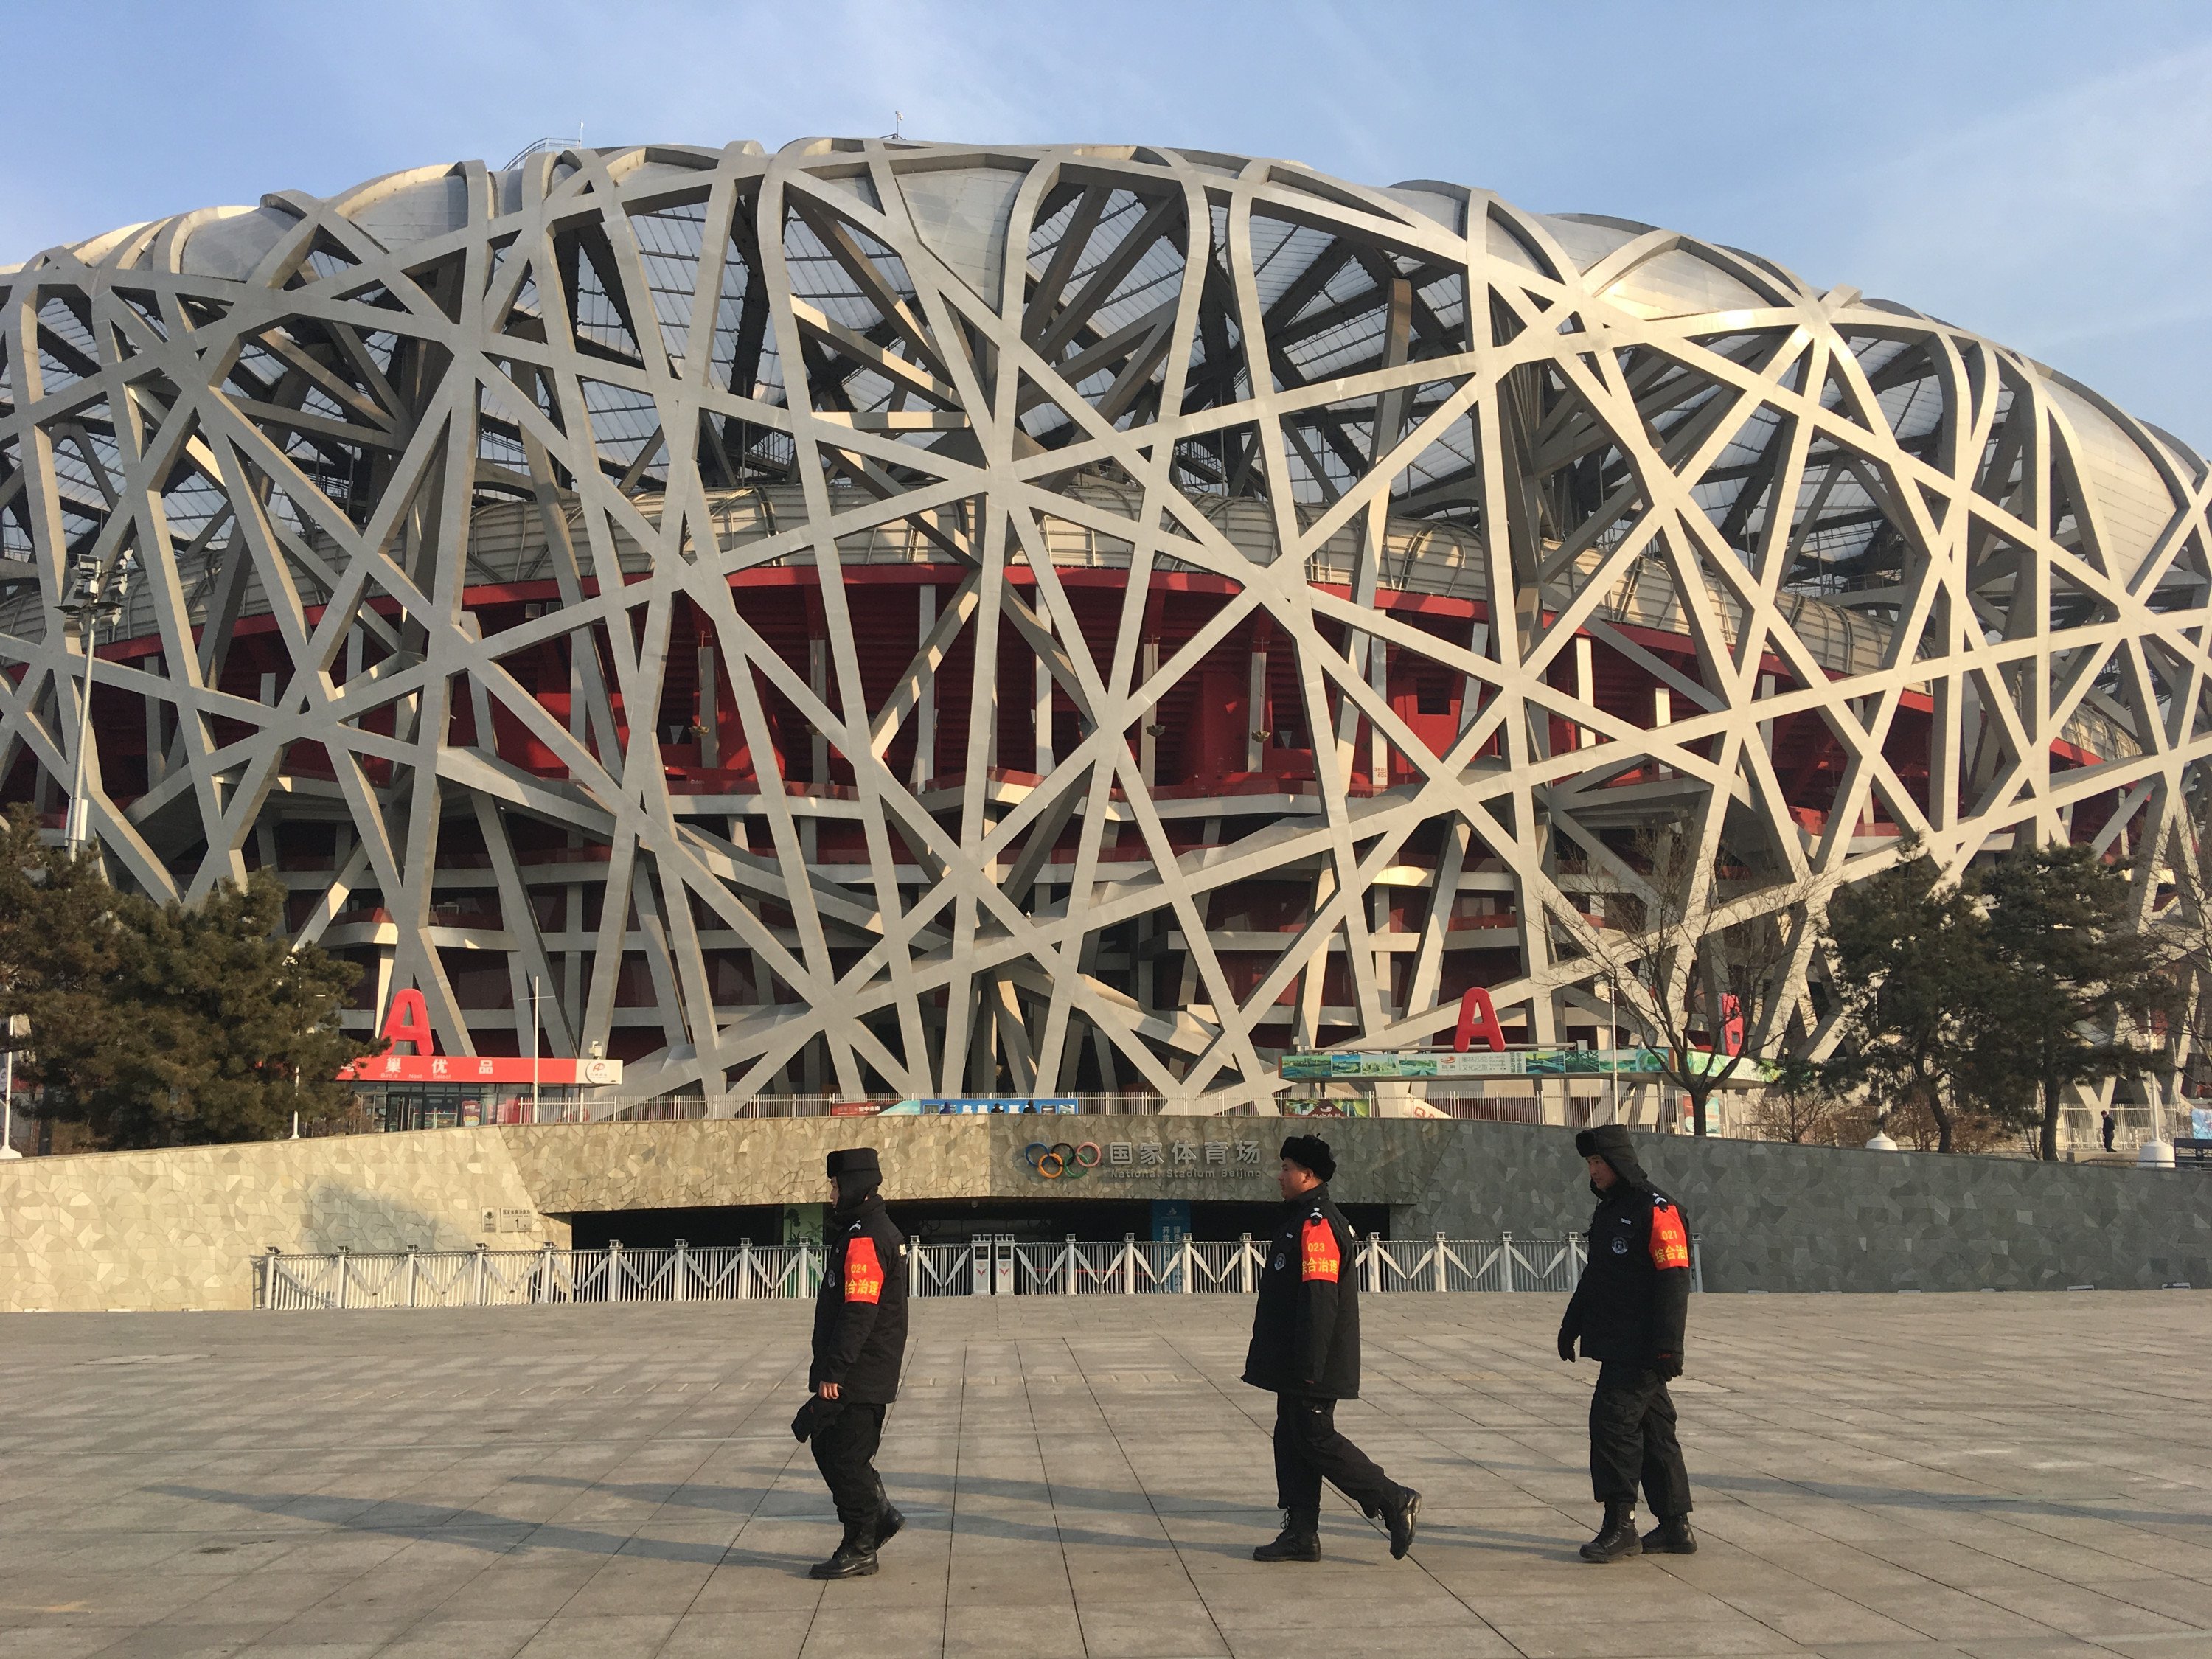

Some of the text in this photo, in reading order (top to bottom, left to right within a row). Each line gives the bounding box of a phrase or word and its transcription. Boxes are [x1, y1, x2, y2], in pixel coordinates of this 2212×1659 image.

[380, 989, 434, 1055] A
[1453, 987, 1506, 1052] A
[1110, 1140, 1261, 1164] 国家体育场
[1111, 1169, 1262, 1178] National Stadium Beijing
[1662, 1230, 1677, 1240] 021
[1307, 1243, 1325, 1252] 023
[1655, 1244, 1688, 1263] 综合治
[851, 1264, 867, 1273] 024
